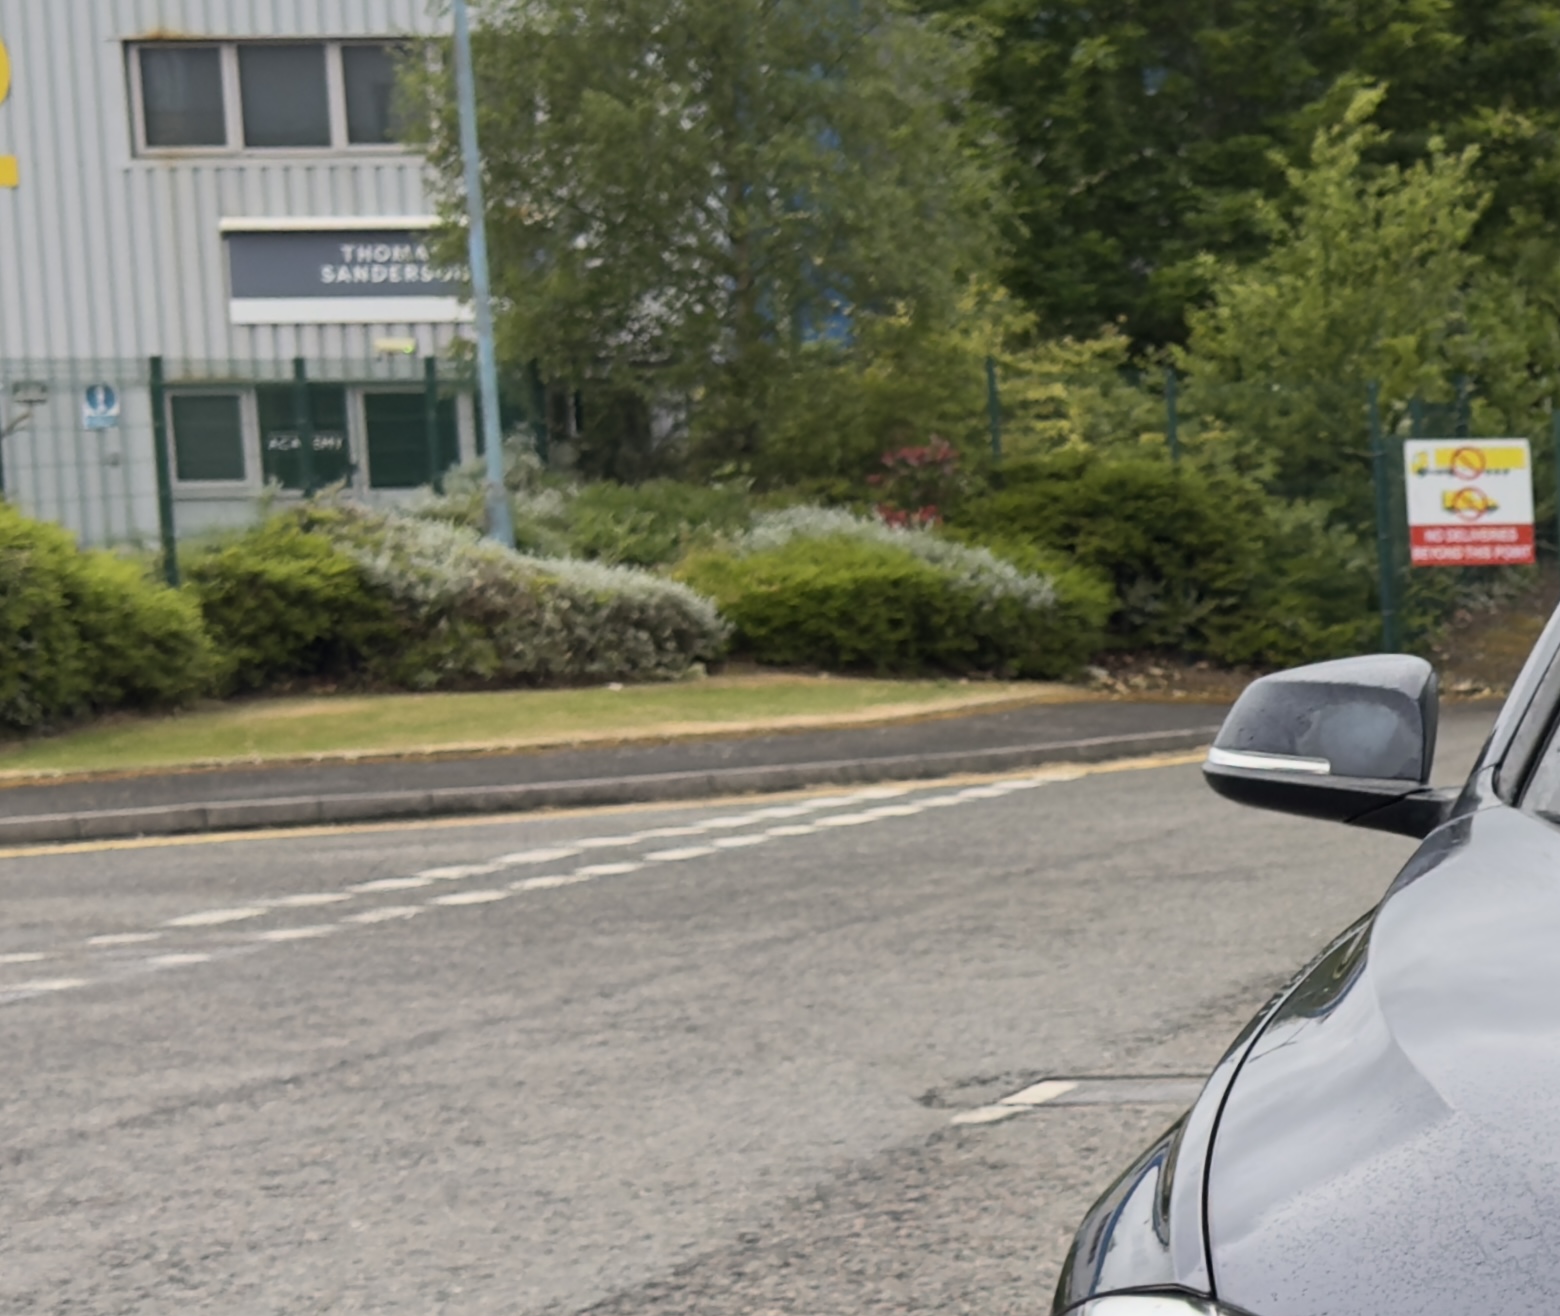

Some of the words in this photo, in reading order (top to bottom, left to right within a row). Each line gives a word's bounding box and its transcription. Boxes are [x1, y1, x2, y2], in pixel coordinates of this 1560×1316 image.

[341, 243, 439, 263] THOMA
[1424, 528, 1444, 543] NO
[1447, 527, 1518, 542] DELIVERIES
[1412, 546, 1463, 561] BEYOND
[1466, 544, 1491, 560] THIS
[1495, 544, 1532, 560] POINT
